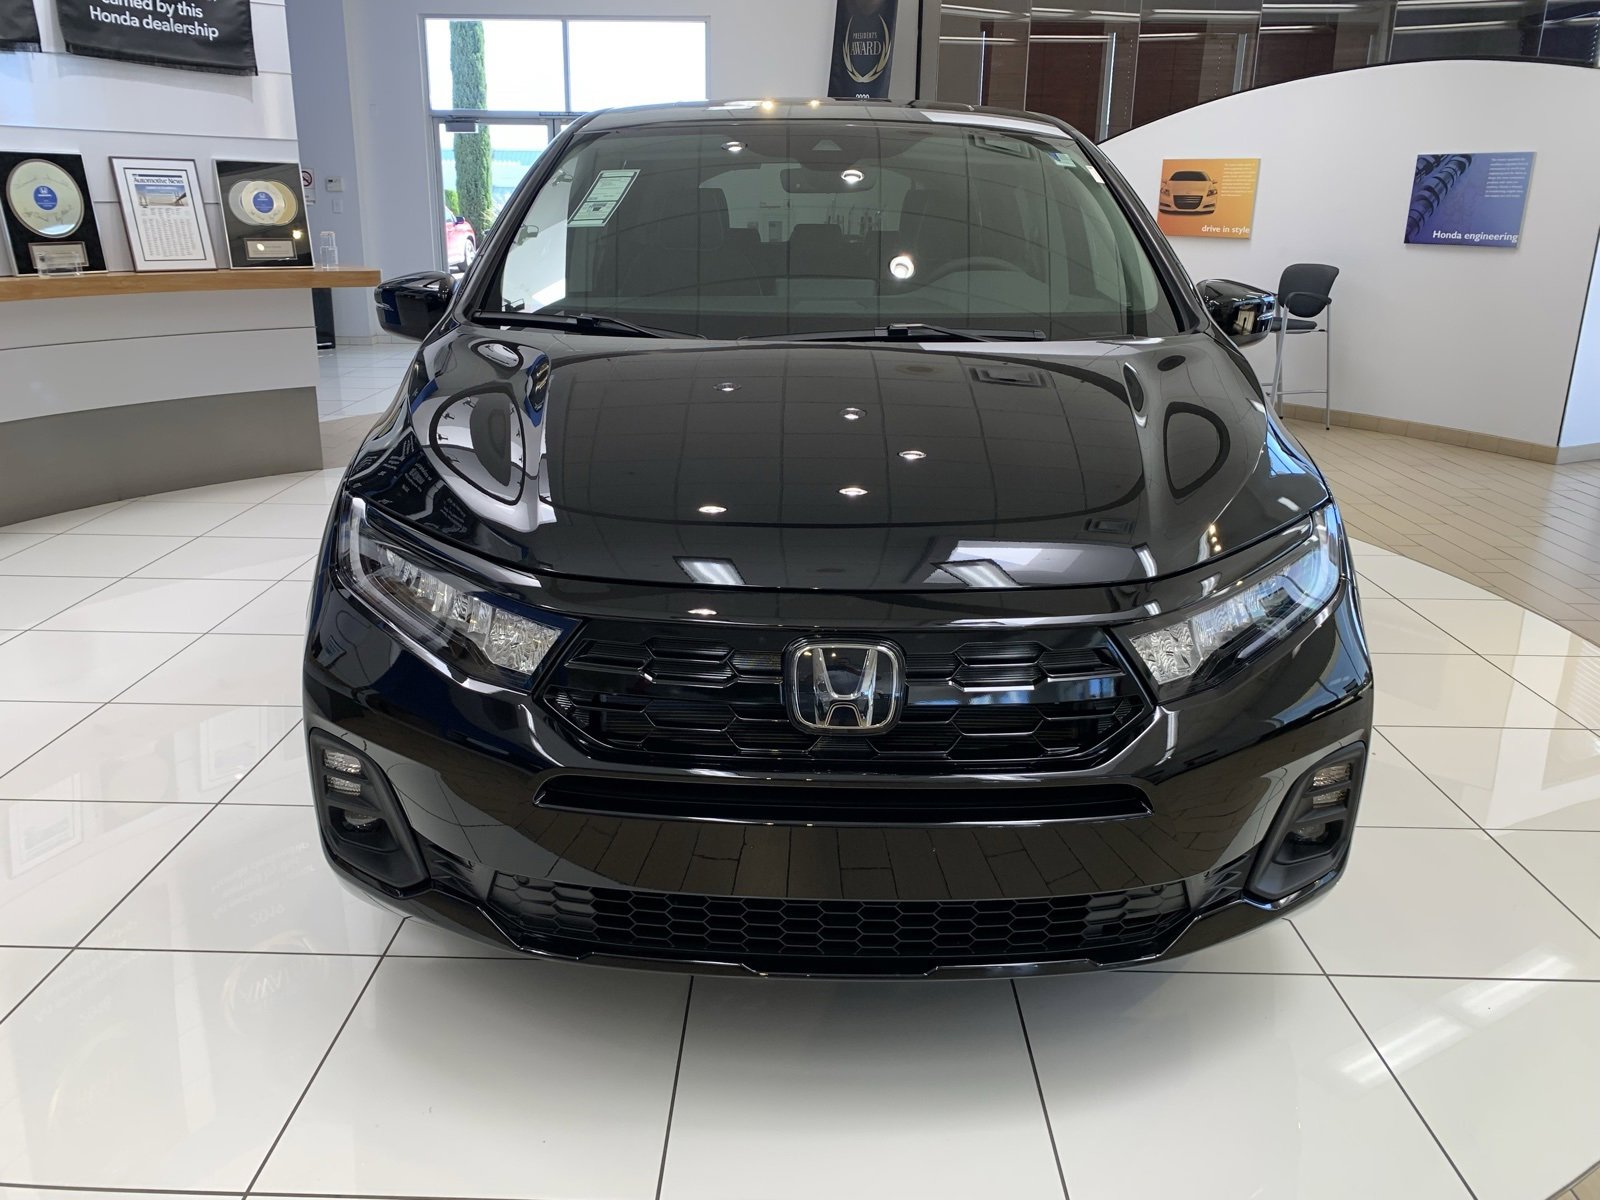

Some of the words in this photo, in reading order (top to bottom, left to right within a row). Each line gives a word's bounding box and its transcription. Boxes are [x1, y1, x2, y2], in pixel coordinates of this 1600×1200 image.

[156, 0, 175, 17] by
[177, 1, 204, 18] this
[89, 5, 140, 27] Honda
[142, 15, 219, 41] dealership
[850, 41, 881, 55] AWARD
[1231, 226, 1250, 235] style
[1432, 230, 1462, 240] Honda
[1464, 232, 1519, 243] engineering
